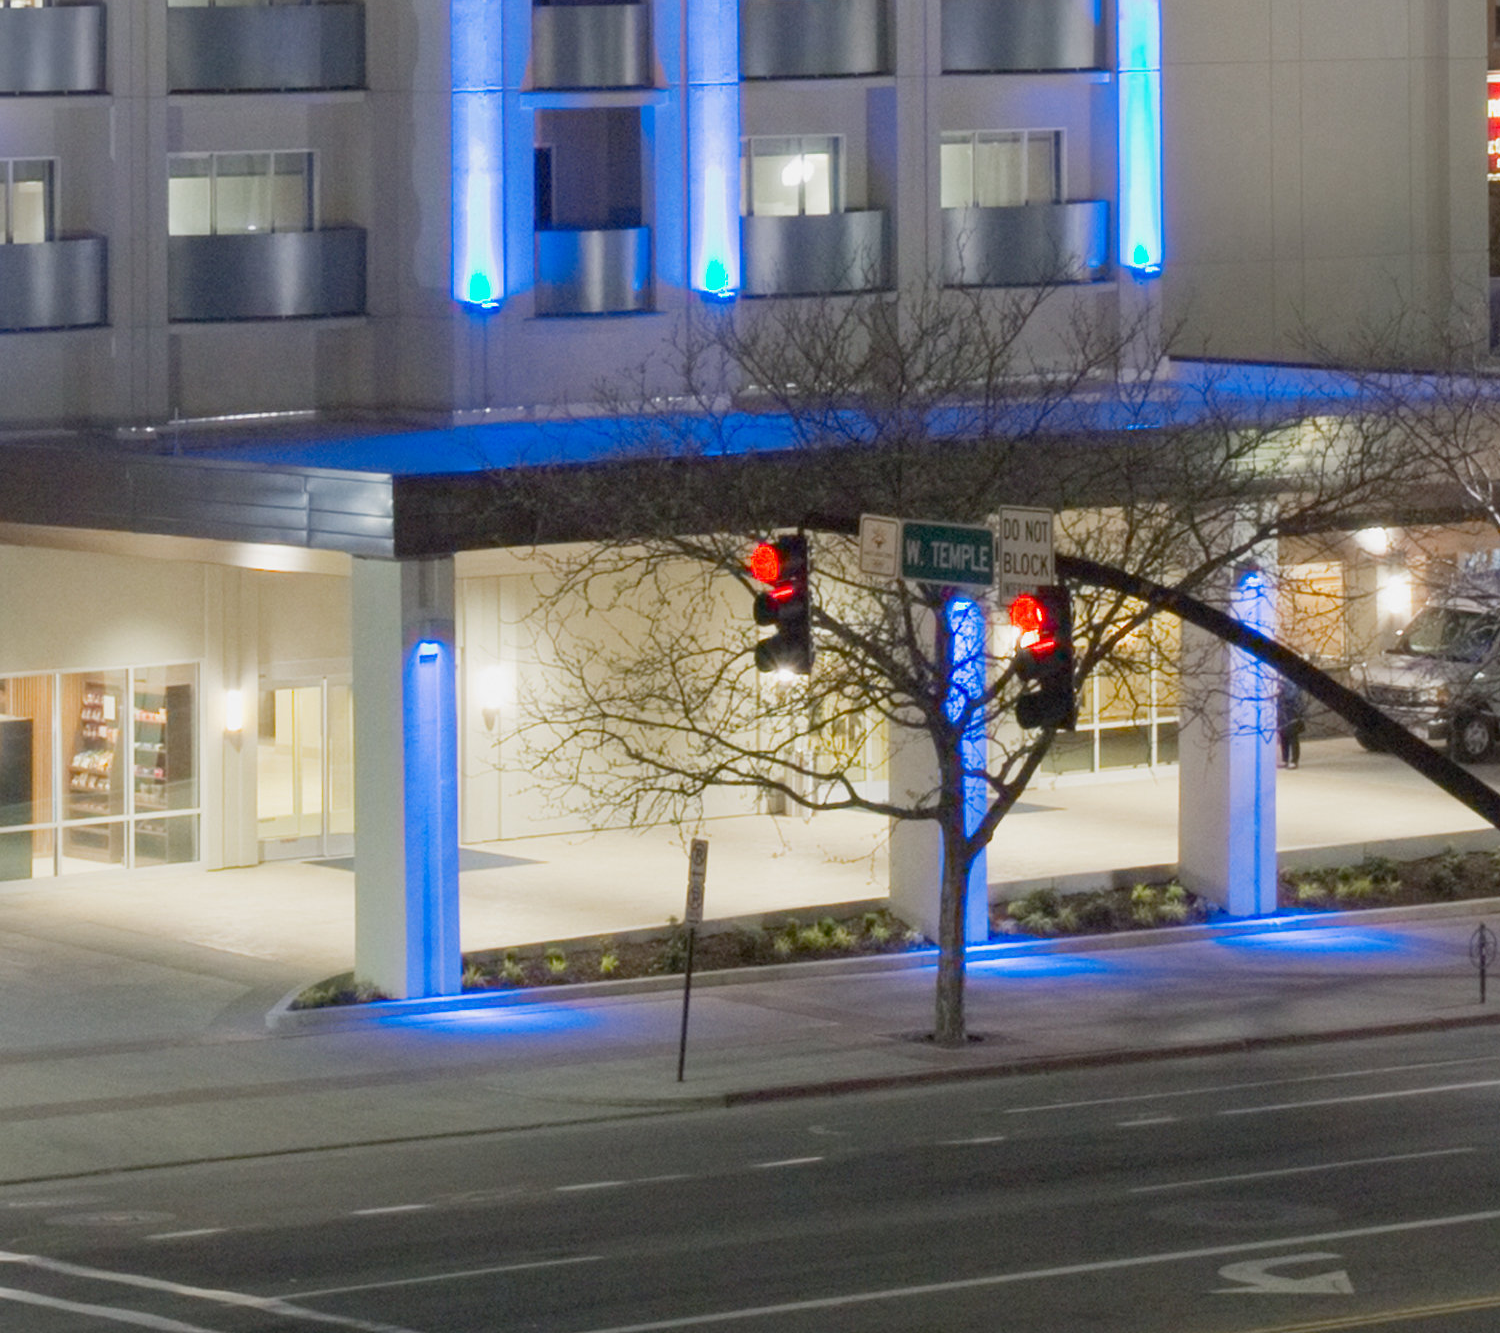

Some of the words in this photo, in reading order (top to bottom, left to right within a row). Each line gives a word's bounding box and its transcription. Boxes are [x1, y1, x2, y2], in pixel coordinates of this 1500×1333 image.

[1003, 517, 1019, 541] DO
[1025, 520, 1049, 544] NOT
[906, 540, 925, 566] W.
[930, 541, 990, 573] TEMPLE
[1003, 552, 1050, 577] BLOCK
